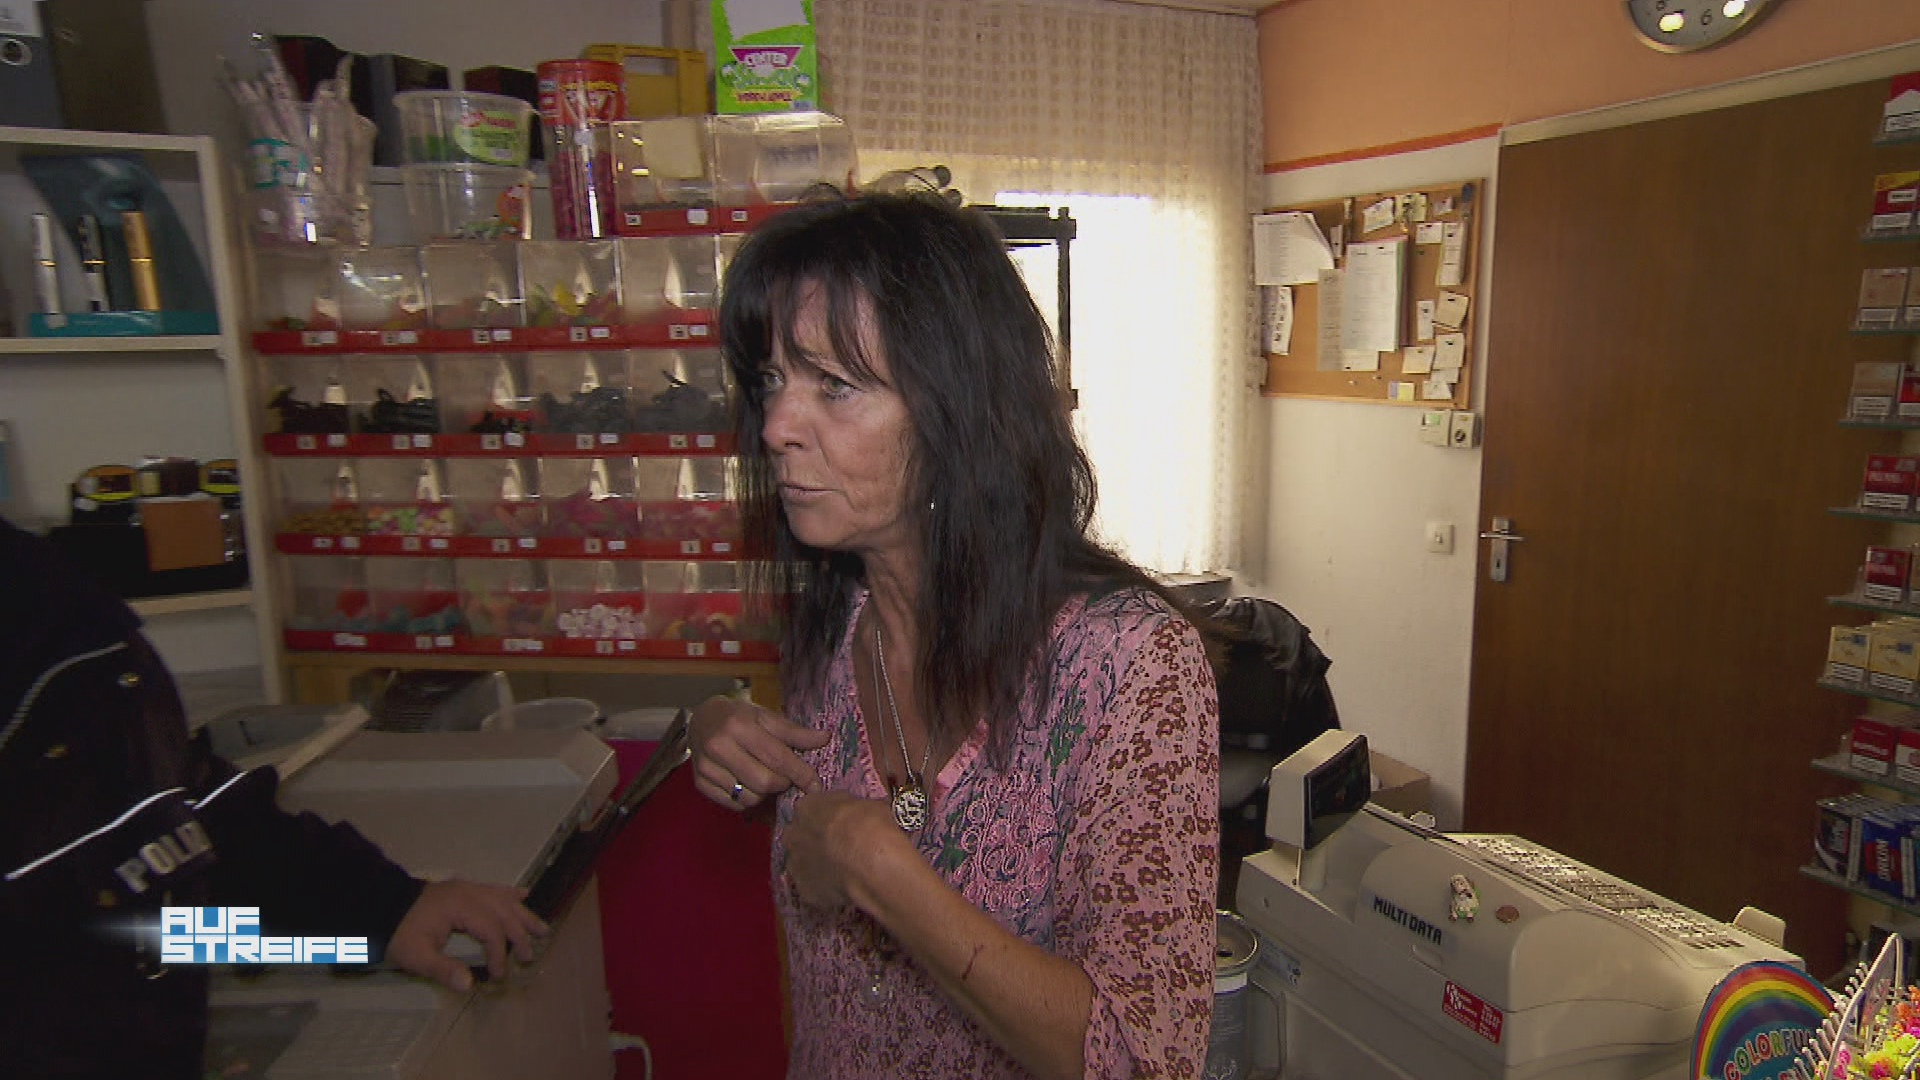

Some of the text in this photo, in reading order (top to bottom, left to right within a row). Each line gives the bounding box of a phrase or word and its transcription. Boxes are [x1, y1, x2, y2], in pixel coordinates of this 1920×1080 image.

[1701, 9, 1713, 26] 6
[1373, 895, 1442, 946] MULTI DATA
